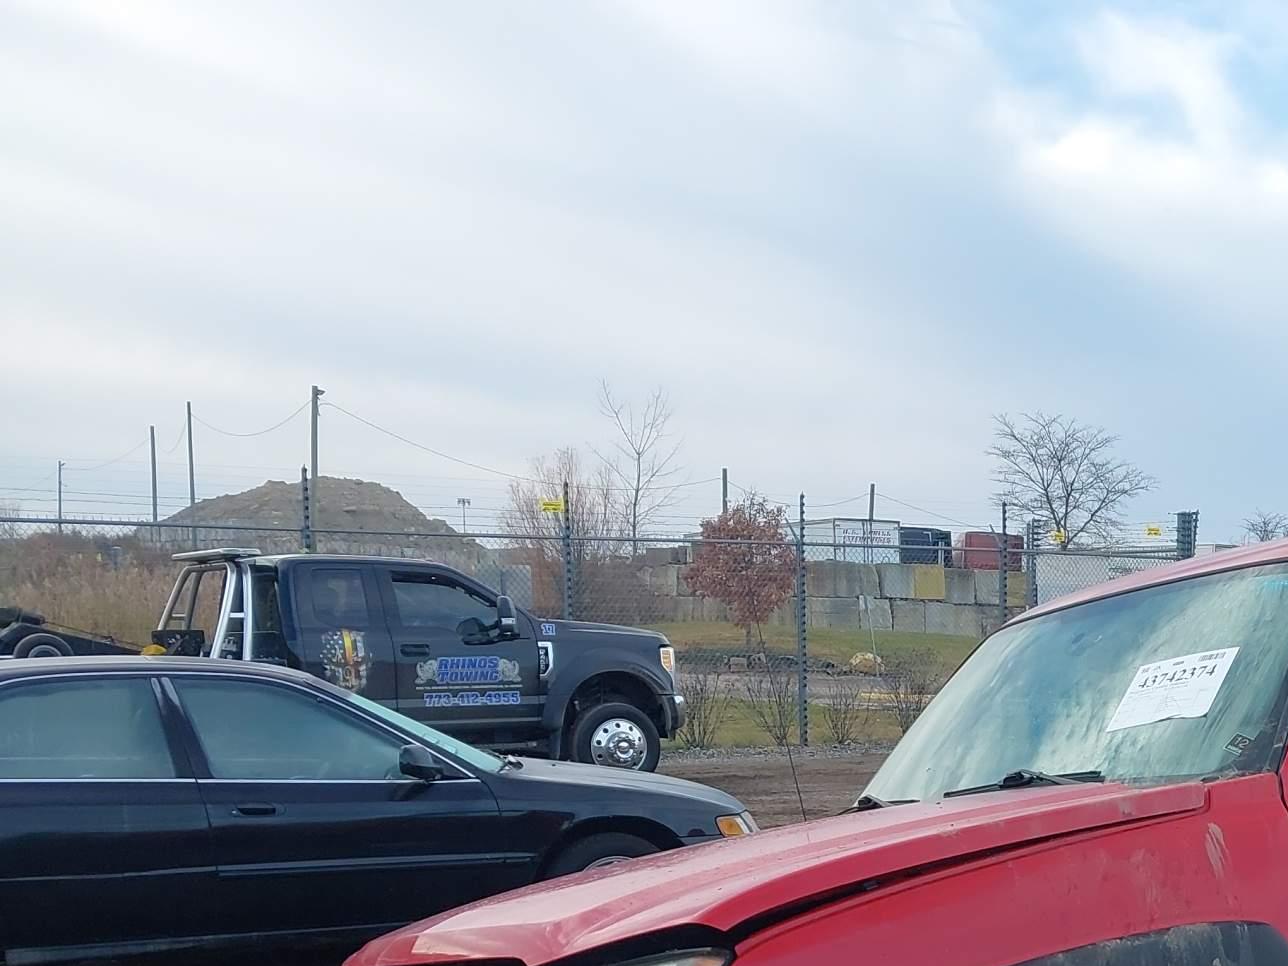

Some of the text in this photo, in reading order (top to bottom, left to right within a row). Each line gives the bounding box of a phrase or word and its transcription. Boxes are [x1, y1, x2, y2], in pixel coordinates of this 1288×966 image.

[437, 657, 499, 669] RHINOS
[438, 670, 500, 682] TOWING
[1138, 664, 1217, 688] 43742374
[424, 692, 520, 706] 773-412-4955
